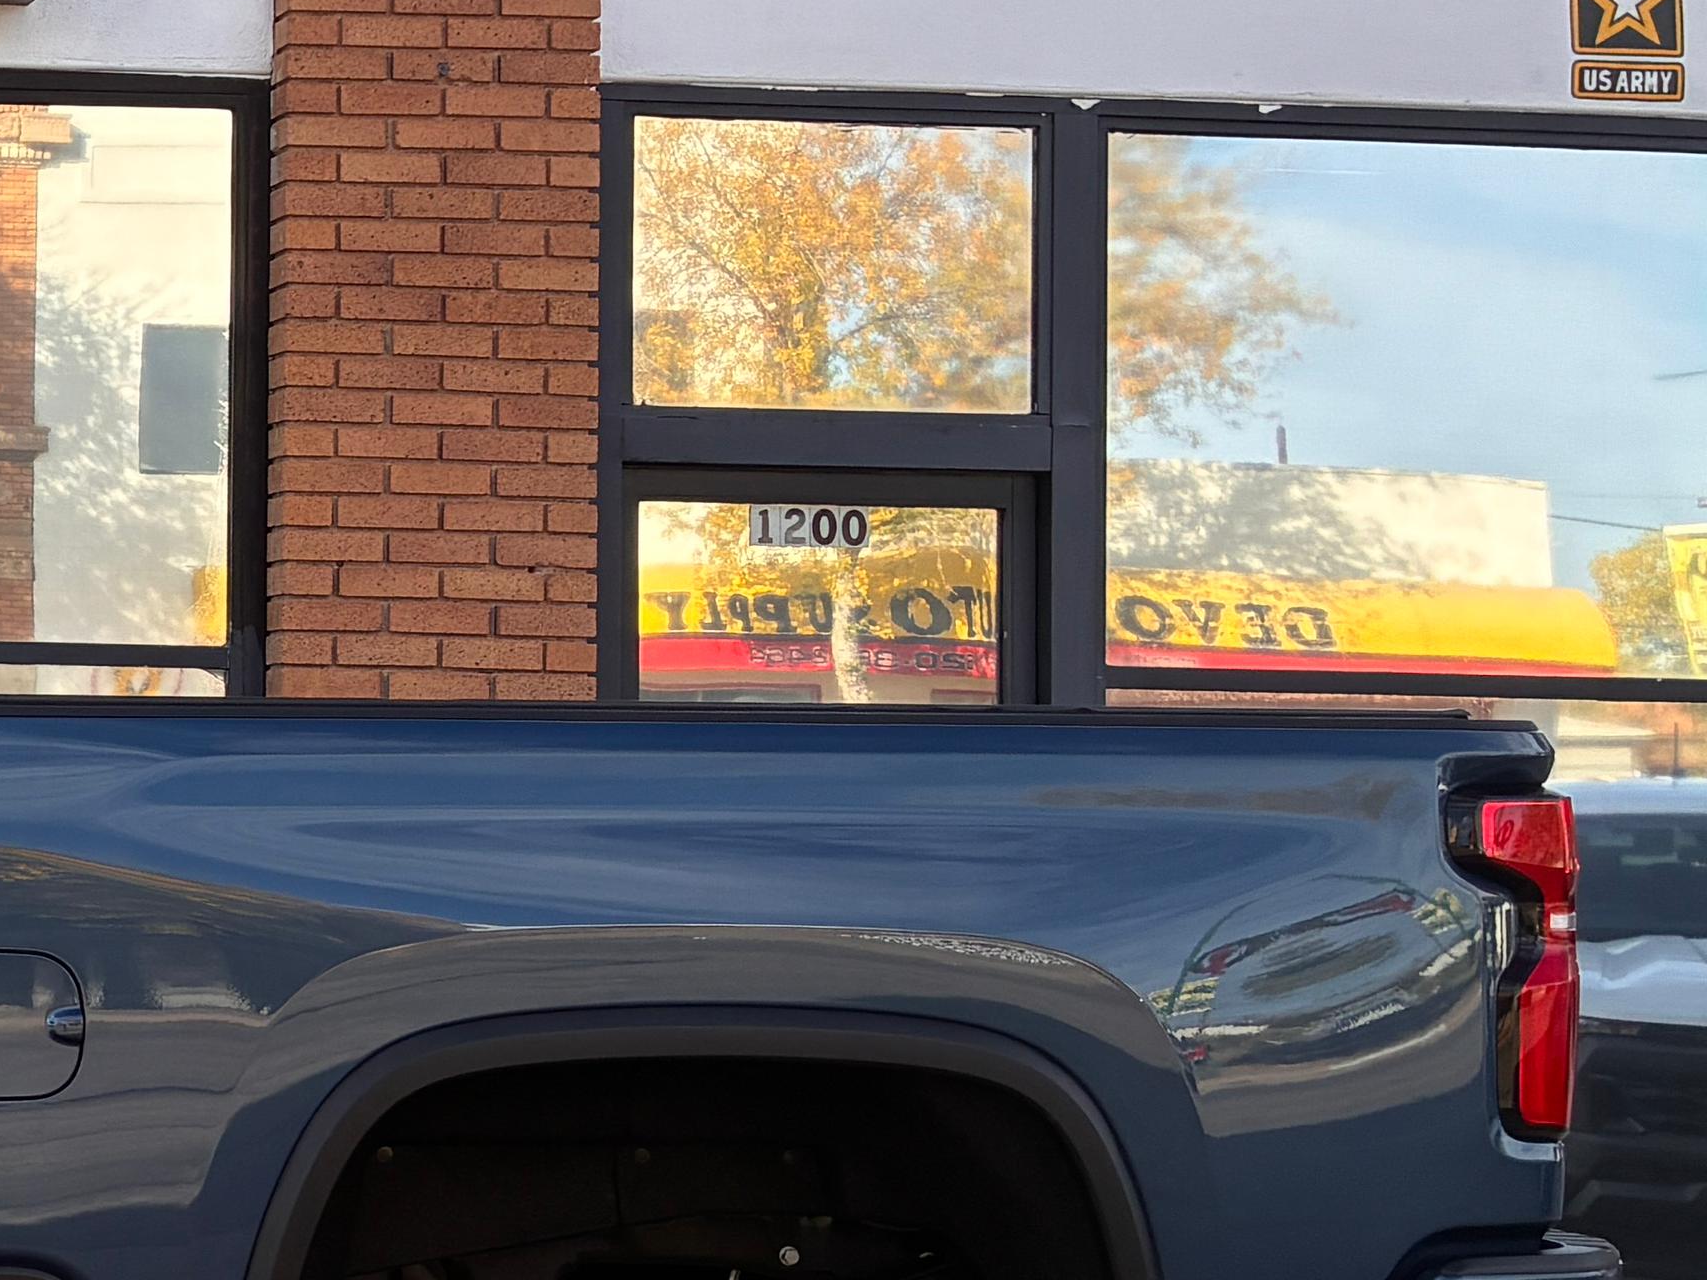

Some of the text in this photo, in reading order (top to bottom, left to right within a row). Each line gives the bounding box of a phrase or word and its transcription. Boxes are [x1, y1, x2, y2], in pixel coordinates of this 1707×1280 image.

[1583, 68, 1673, 94] US ARMY
[756, 507, 868, 546] 1200
